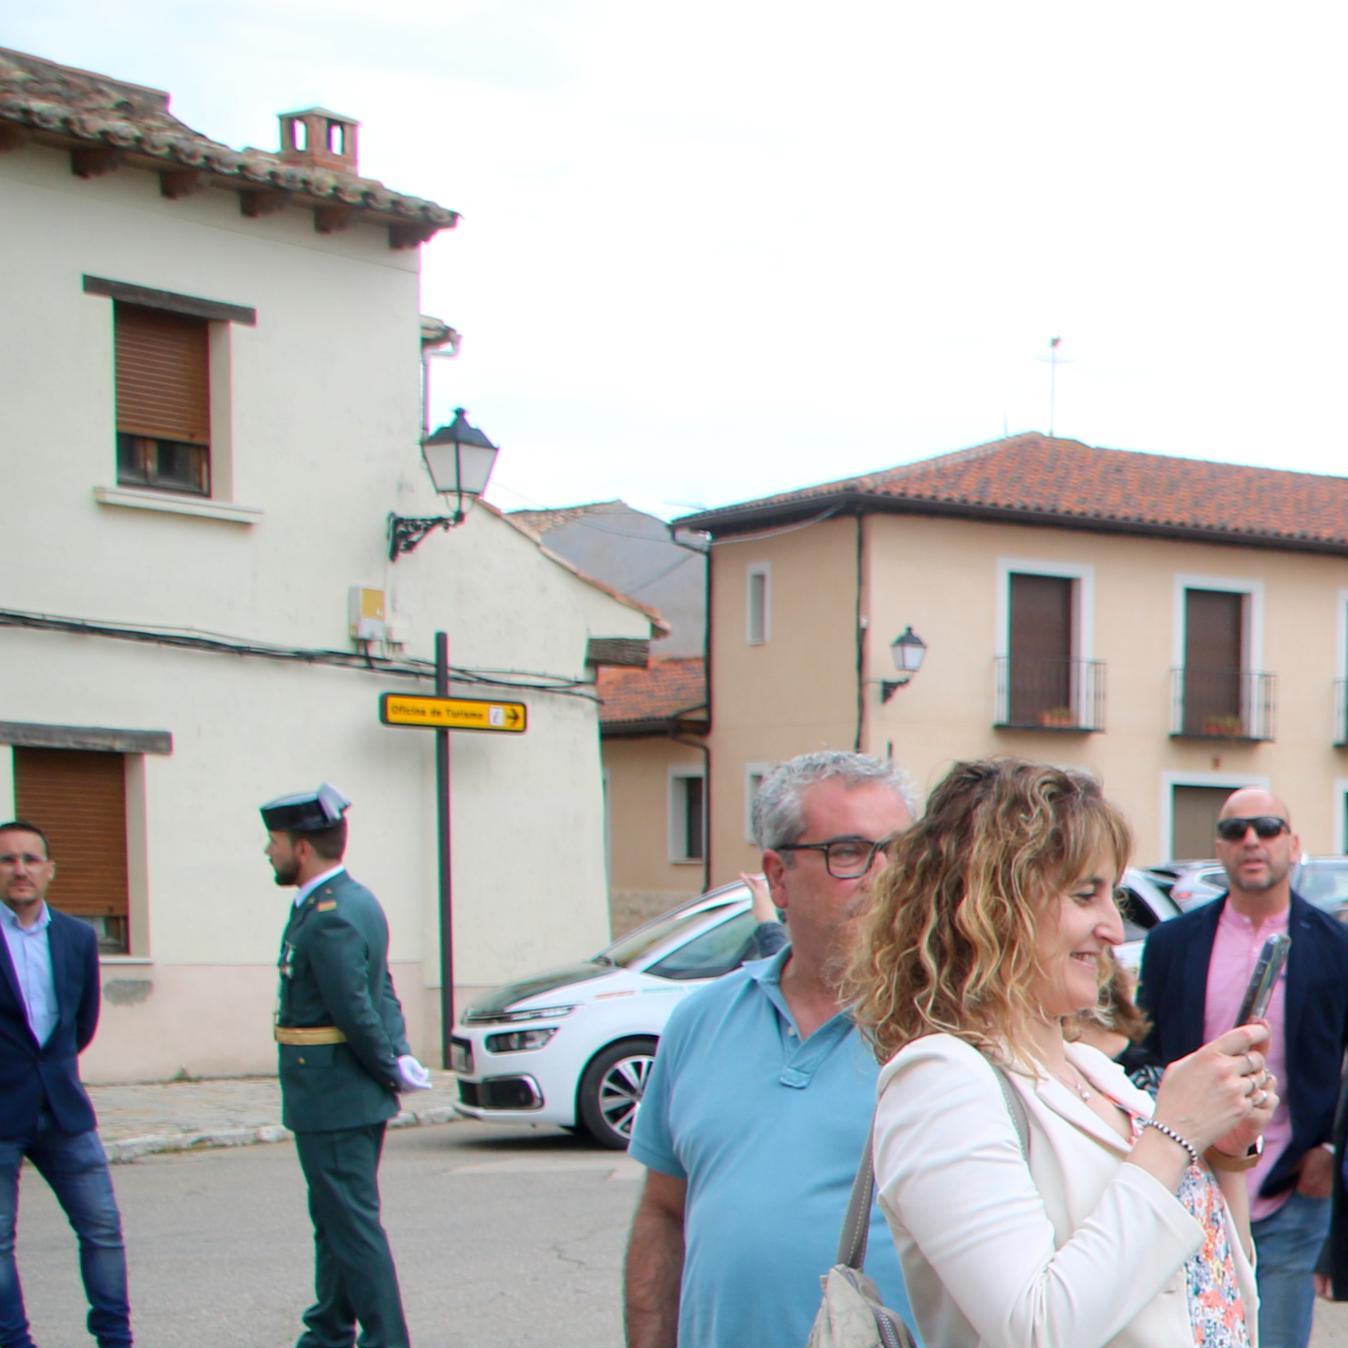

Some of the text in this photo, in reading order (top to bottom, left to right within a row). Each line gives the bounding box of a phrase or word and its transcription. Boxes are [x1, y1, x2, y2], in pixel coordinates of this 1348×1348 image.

[391, 703, 484, 720] Oficina de Turismo
